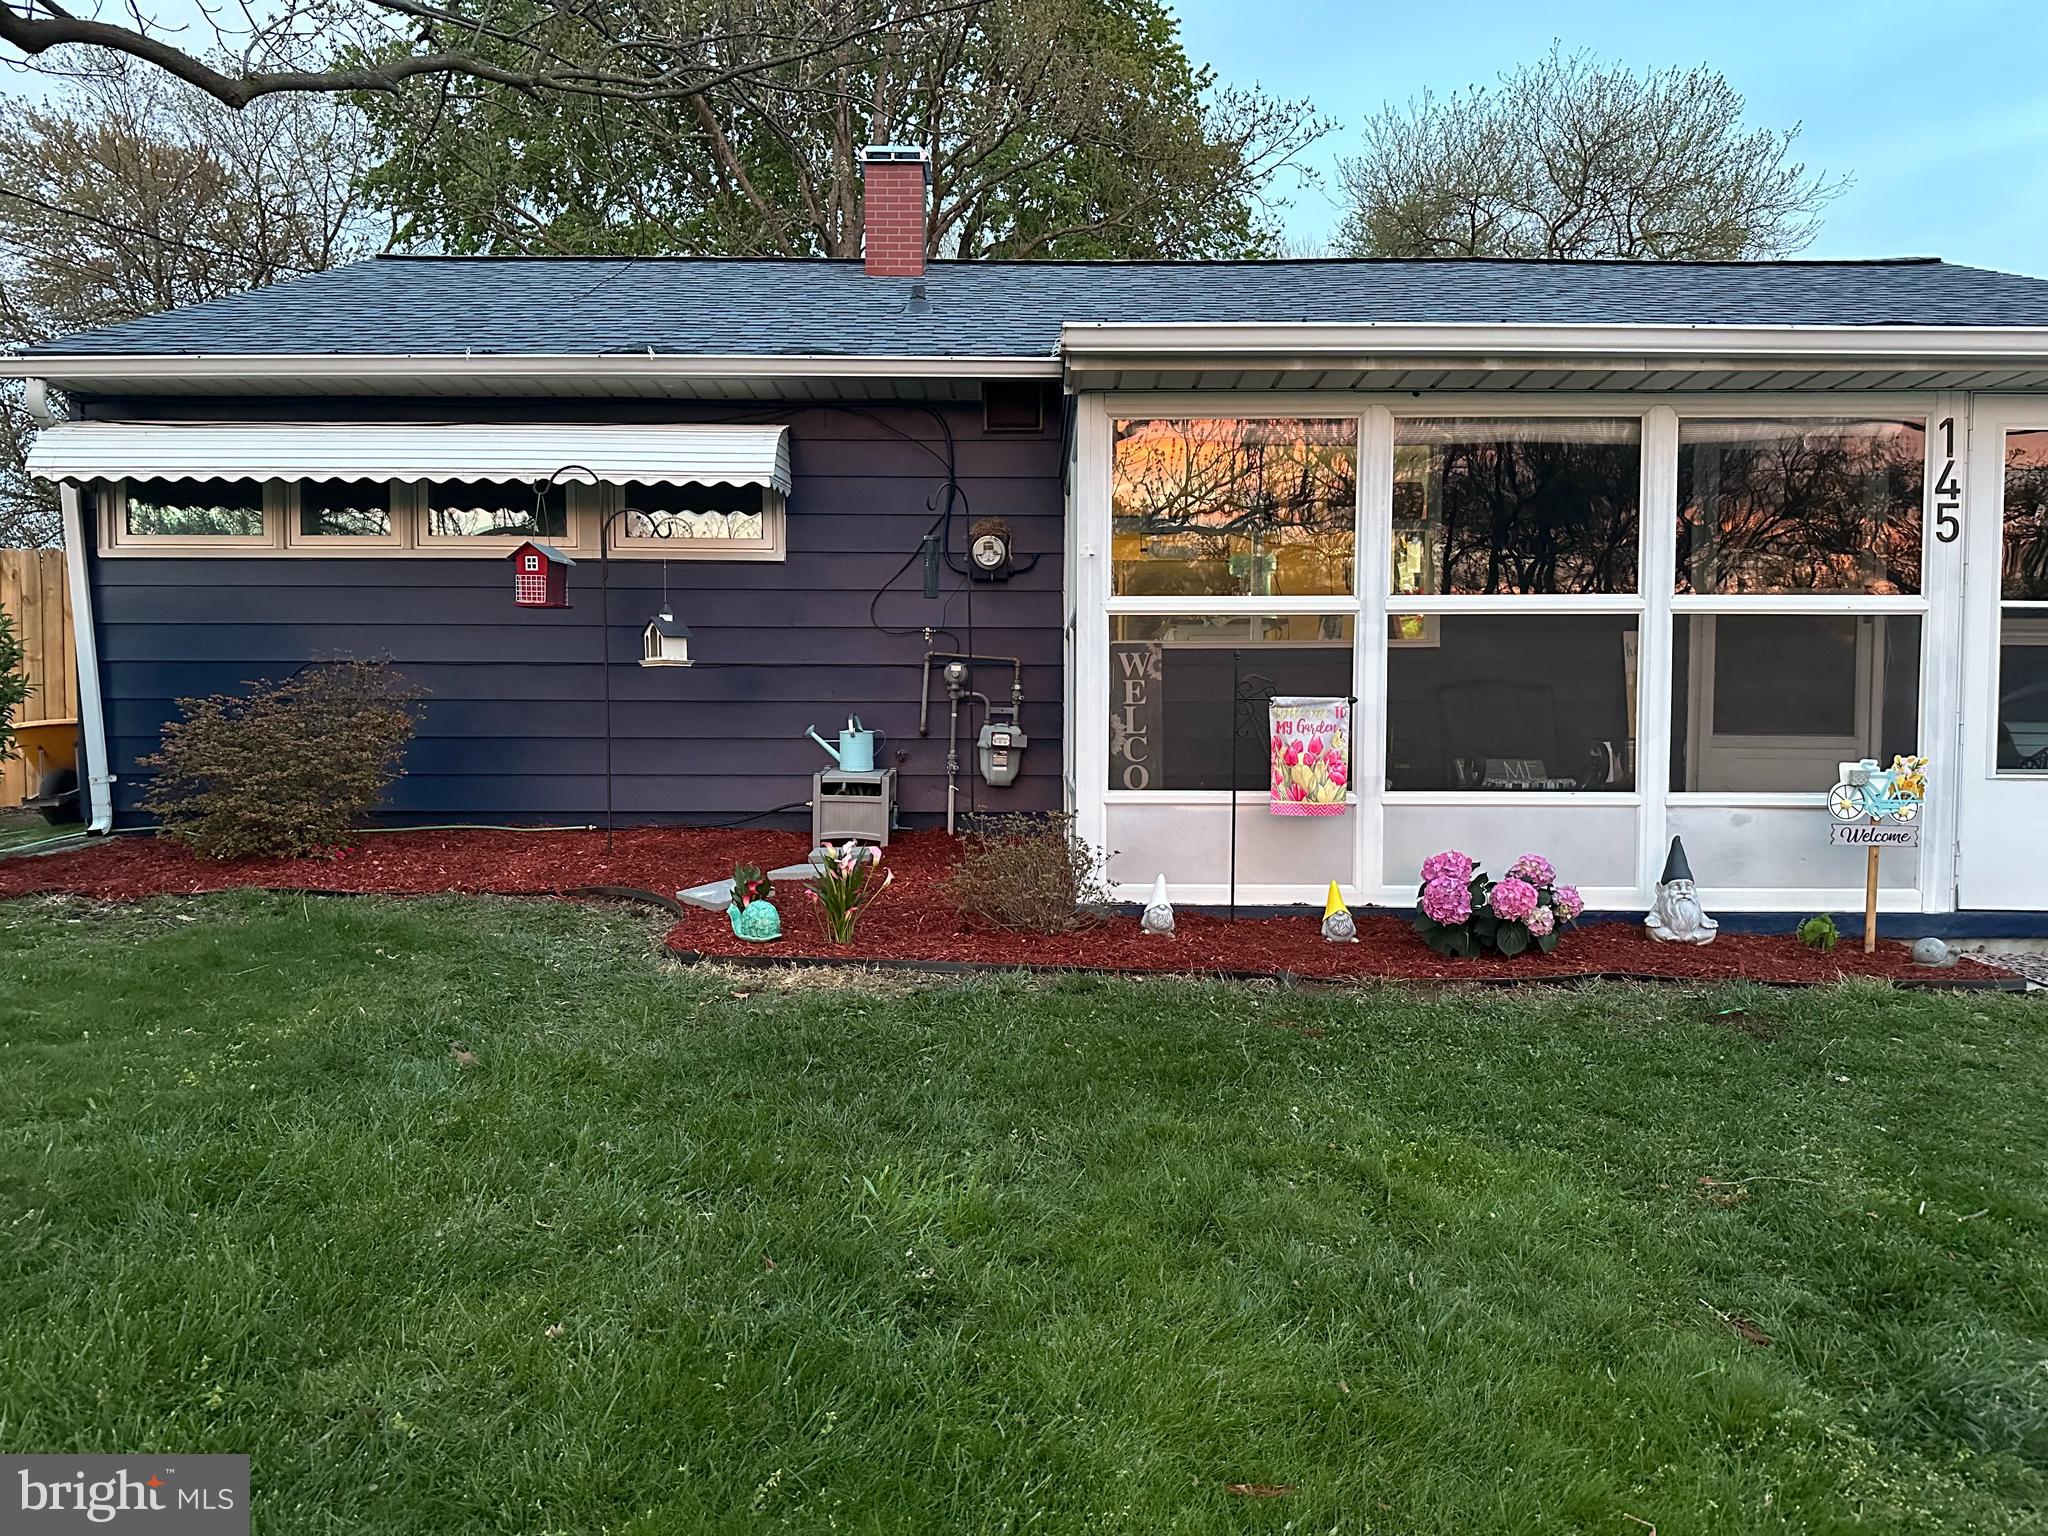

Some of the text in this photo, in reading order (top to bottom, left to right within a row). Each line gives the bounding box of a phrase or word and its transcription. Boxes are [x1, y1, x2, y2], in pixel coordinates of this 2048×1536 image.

[1935, 417, 1961, 543] 145
[1276, 718, 1337, 735] MY Garden
[1840, 826, 1911, 843] Welcome
